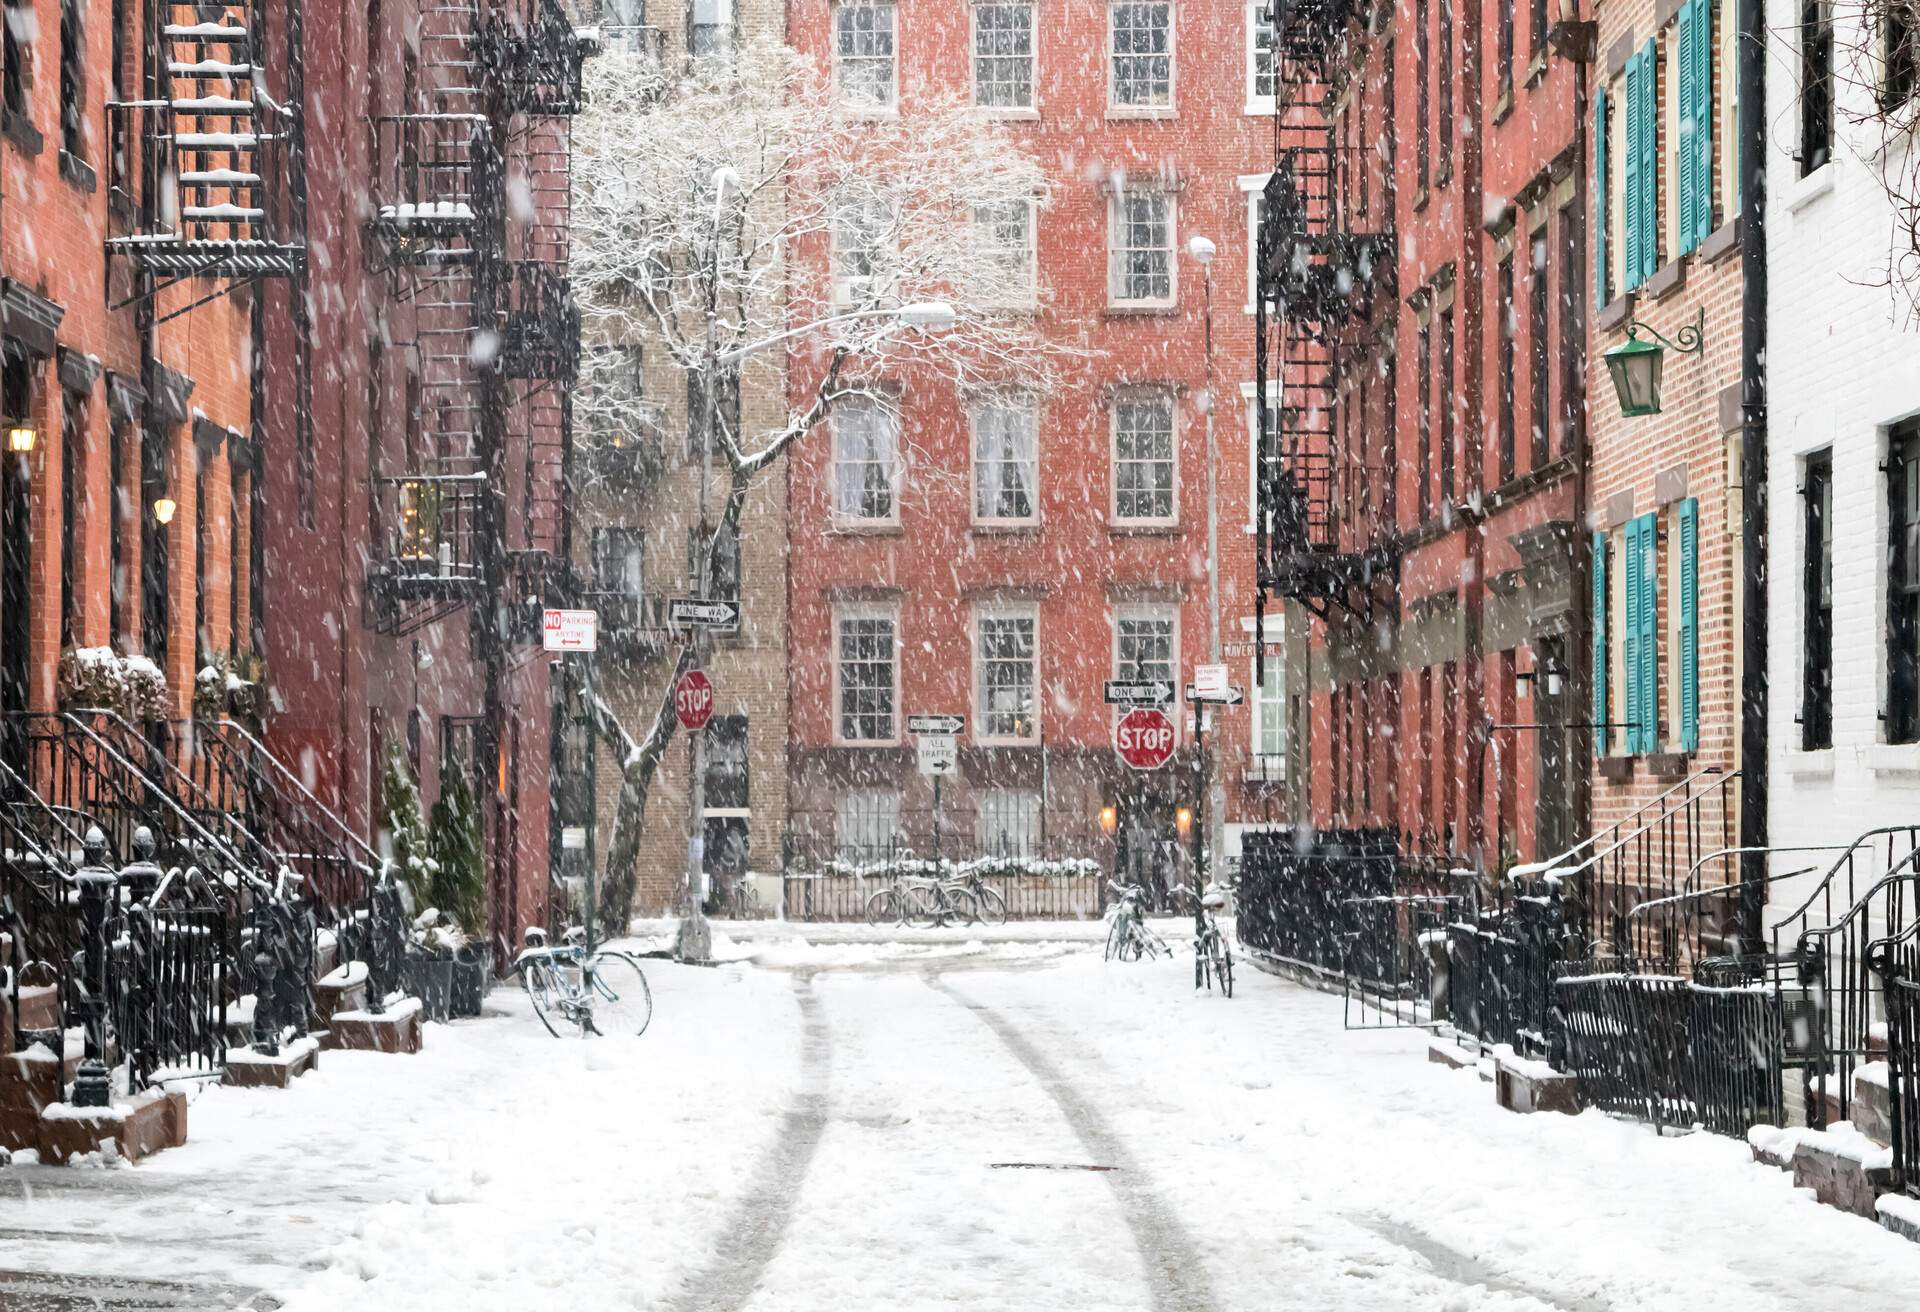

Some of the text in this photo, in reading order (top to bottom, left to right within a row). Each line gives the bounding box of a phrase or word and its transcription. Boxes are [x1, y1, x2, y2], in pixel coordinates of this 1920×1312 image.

[708, 608, 728, 617] WAY
[545, 613, 561, 628] NO
[1115, 687, 1166, 697] ONE WA
[678, 688, 710, 713] STOP
[929, 739, 944, 748] ALL
[1120, 728, 1171, 750] STOP
[921, 750, 953, 758] TRAFFIC
